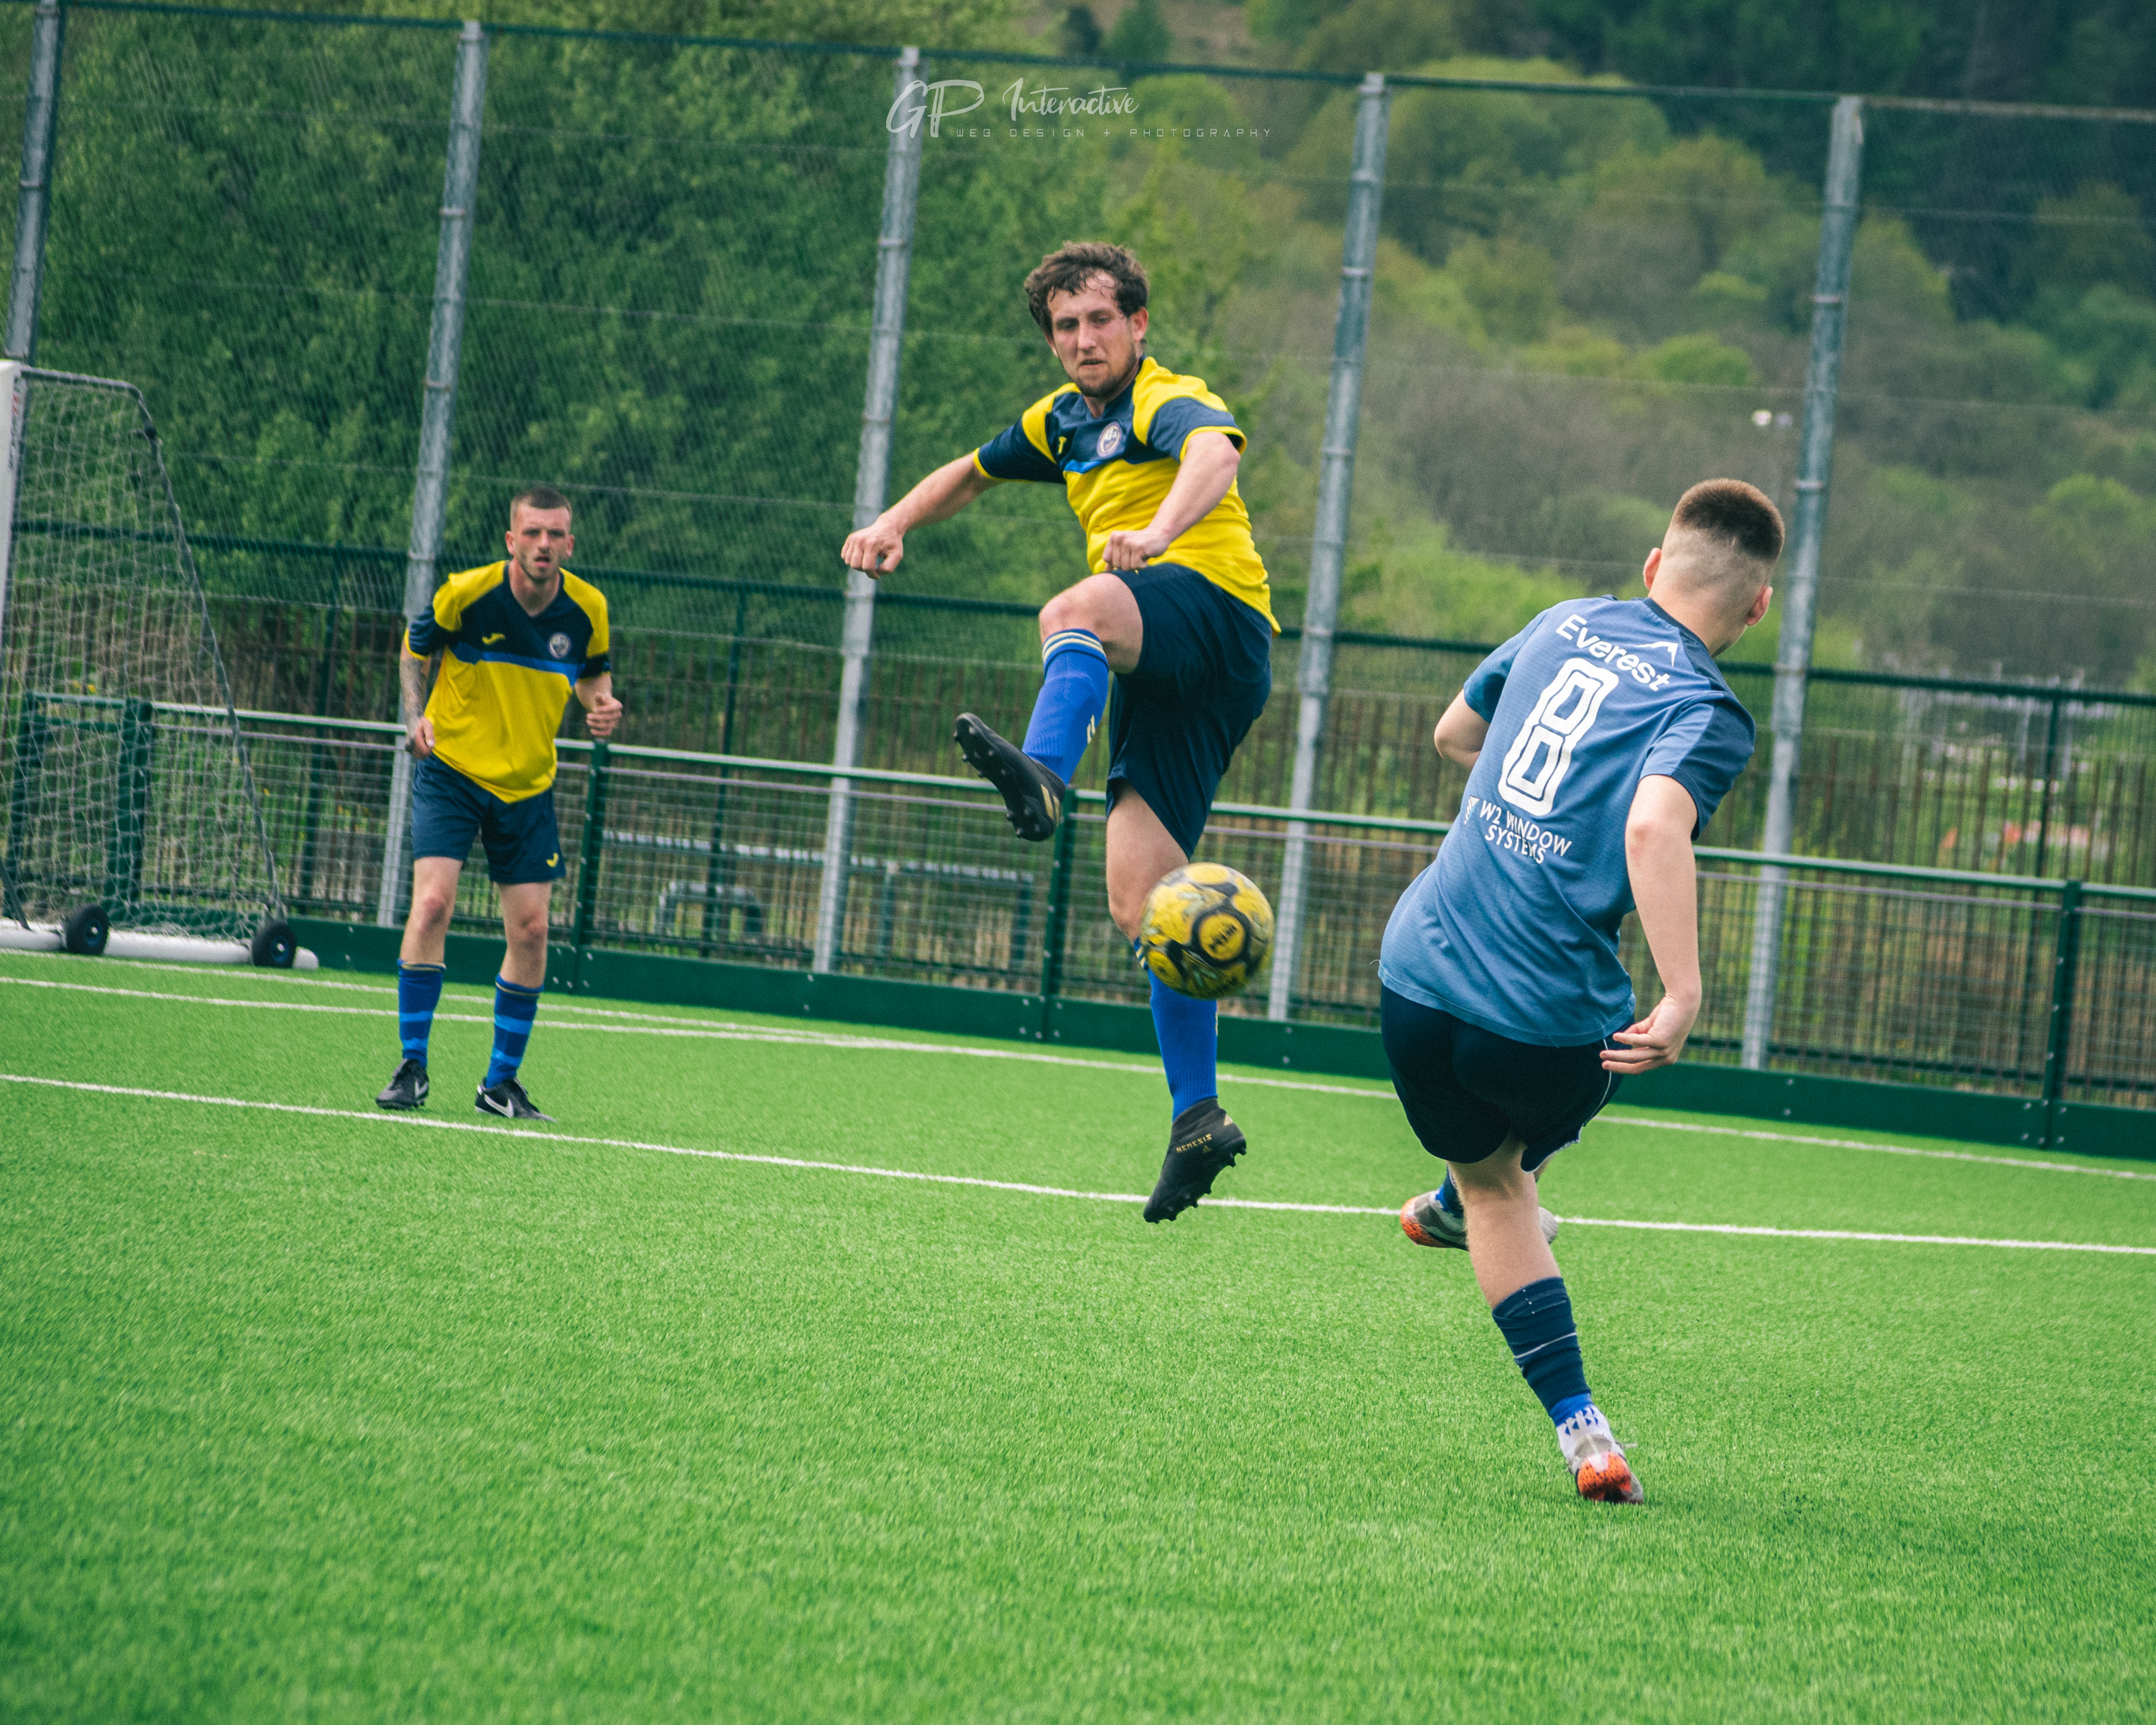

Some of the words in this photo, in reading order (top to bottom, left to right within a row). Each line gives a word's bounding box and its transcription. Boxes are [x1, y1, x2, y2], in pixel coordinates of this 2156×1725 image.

[1555, 614, 1669, 691] Everest
[1498, 657, 1619, 816] 8
[1479, 800, 1502, 825] W2
[1506, 810, 1572, 857] WINDOW
[1485, 824, 1547, 864] SYSTEMS
[1176, 1133, 1212, 1153] NEMESIS
